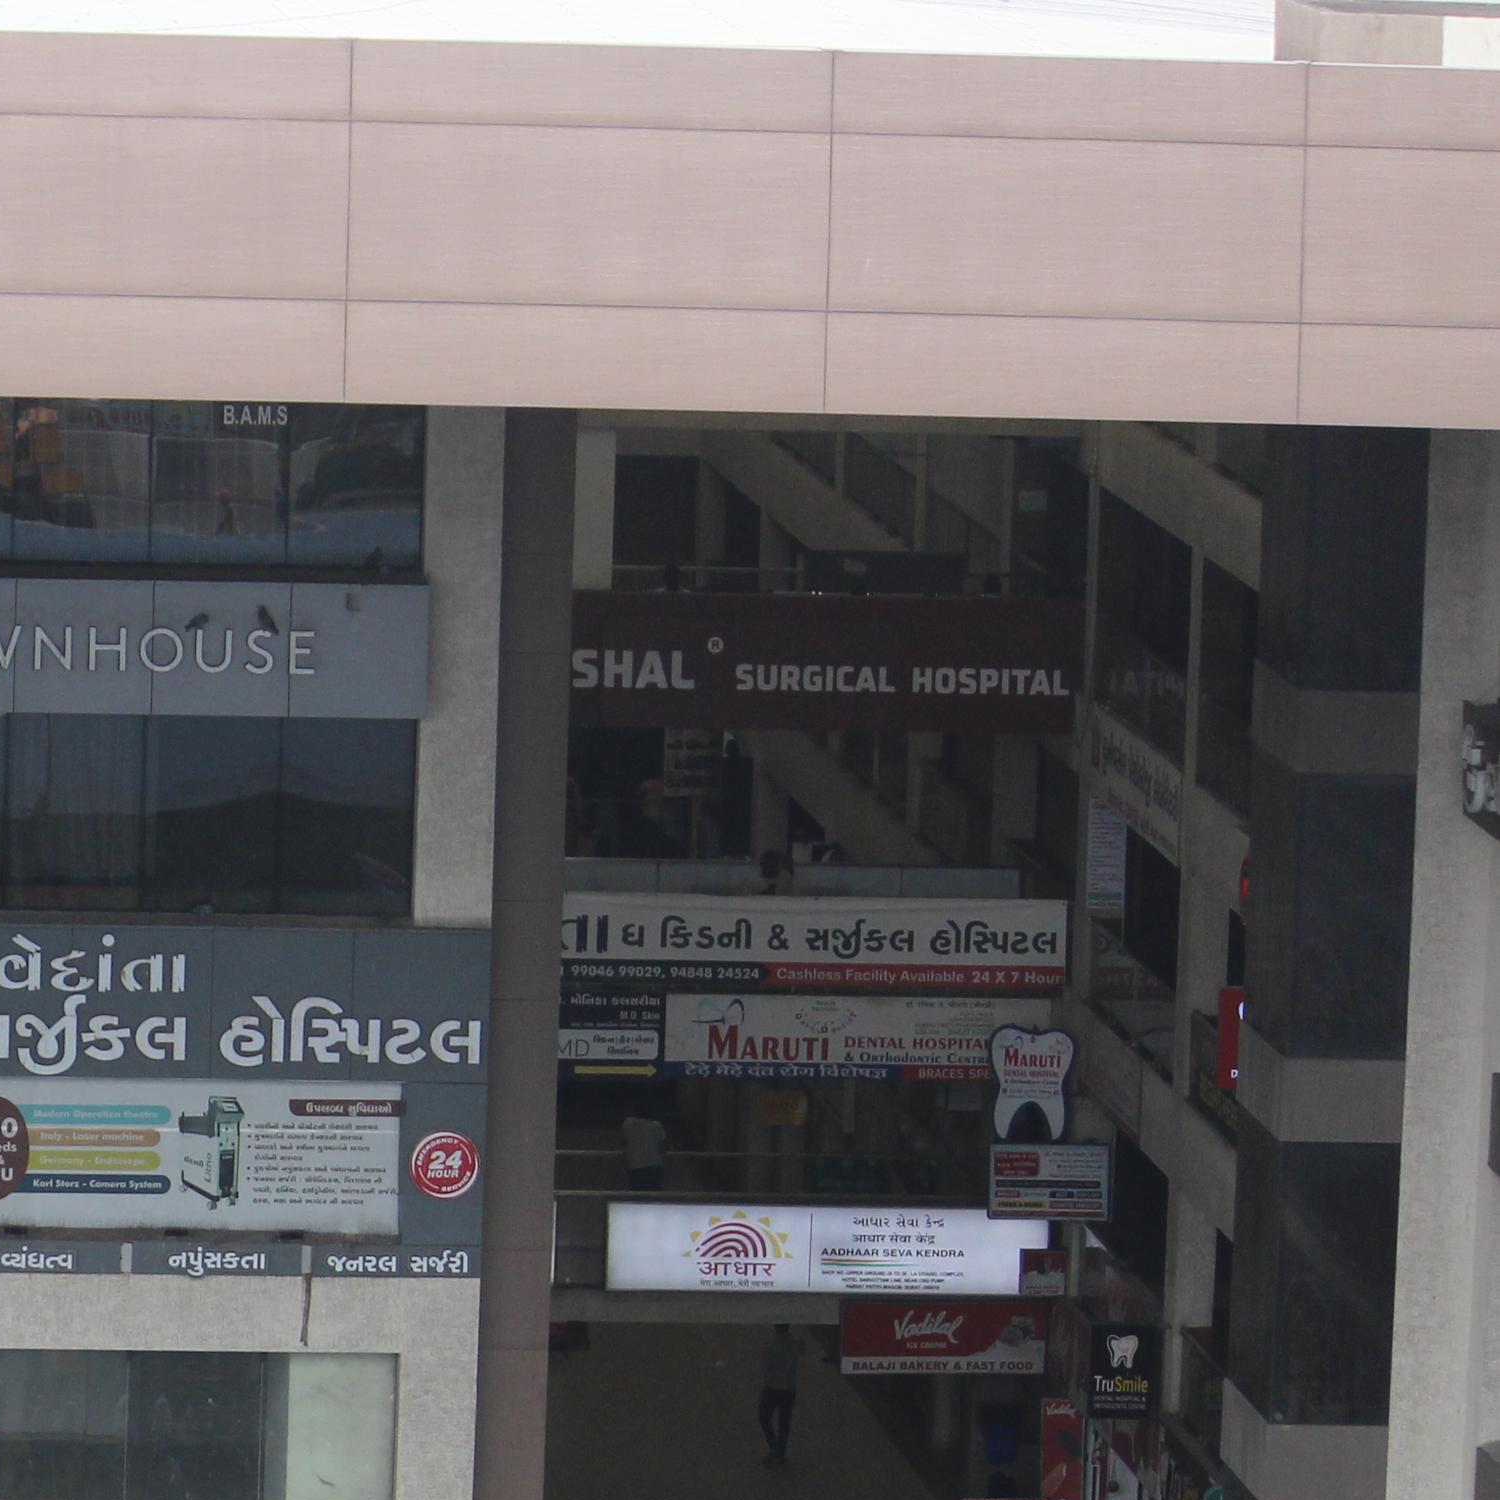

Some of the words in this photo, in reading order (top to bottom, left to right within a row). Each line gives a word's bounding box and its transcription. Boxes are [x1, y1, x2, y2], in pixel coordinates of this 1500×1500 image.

[571, 648, 696, 690] SHAL
[735, 663, 896, 693] SURGICAL
[911, 667, 1070, 697] HOSPITAL
[570, 964, 614, 978] 99046
[617, 965, 666, 980] 99029,
[669, 966, 713, 979] 94848
[717, 967, 760, 980] 24524
[776, 968, 842, 982] Cashless
[845, 968, 896, 985] Facility
[900, 969, 965, 984] Available
[971, 971, 991, 984] 24
[995, 971, 1006, 984] X
[1010, 971, 1019, 984] 7
[1024, 971, 1063, 985] Hour
[217, 996, 483, 1066] હોસ્પિટલ
[1003, 1046, 1062, 1069] MARUTI
[427, 1150, 464, 1170] 24
[426, 1168, 460, 1179] HOUR
[852, 1215, 890, 1230] આધાર
[895, 1213, 920, 1229] સેવા
[852, 1232, 886, 1245] आधार
[887, 1231, 911, 1245] सेवा
[327, 1250, 398, 1273] જનરલ
[409, 1245, 470, 1275] સર્જરી
[820, 1247, 879, 1258] AADHAAR
[881, 1248, 914, 1258] SEVA
[915, 1249, 966, 1259] KENDRA
[697, 1260, 776, 1277] आधार
[894, 1310, 967, 1344] Vadilal
[852, 1360, 897, 1372] BALAJI
[899, 1360, 950, 1372] BAKERY
[953, 1361, 964, 1371] &
[966, 1361, 996, 1371] FAST
[1001, 1361, 1034, 1372] FOOD
[1093, 1375, 1149, 1394] TruSmile
